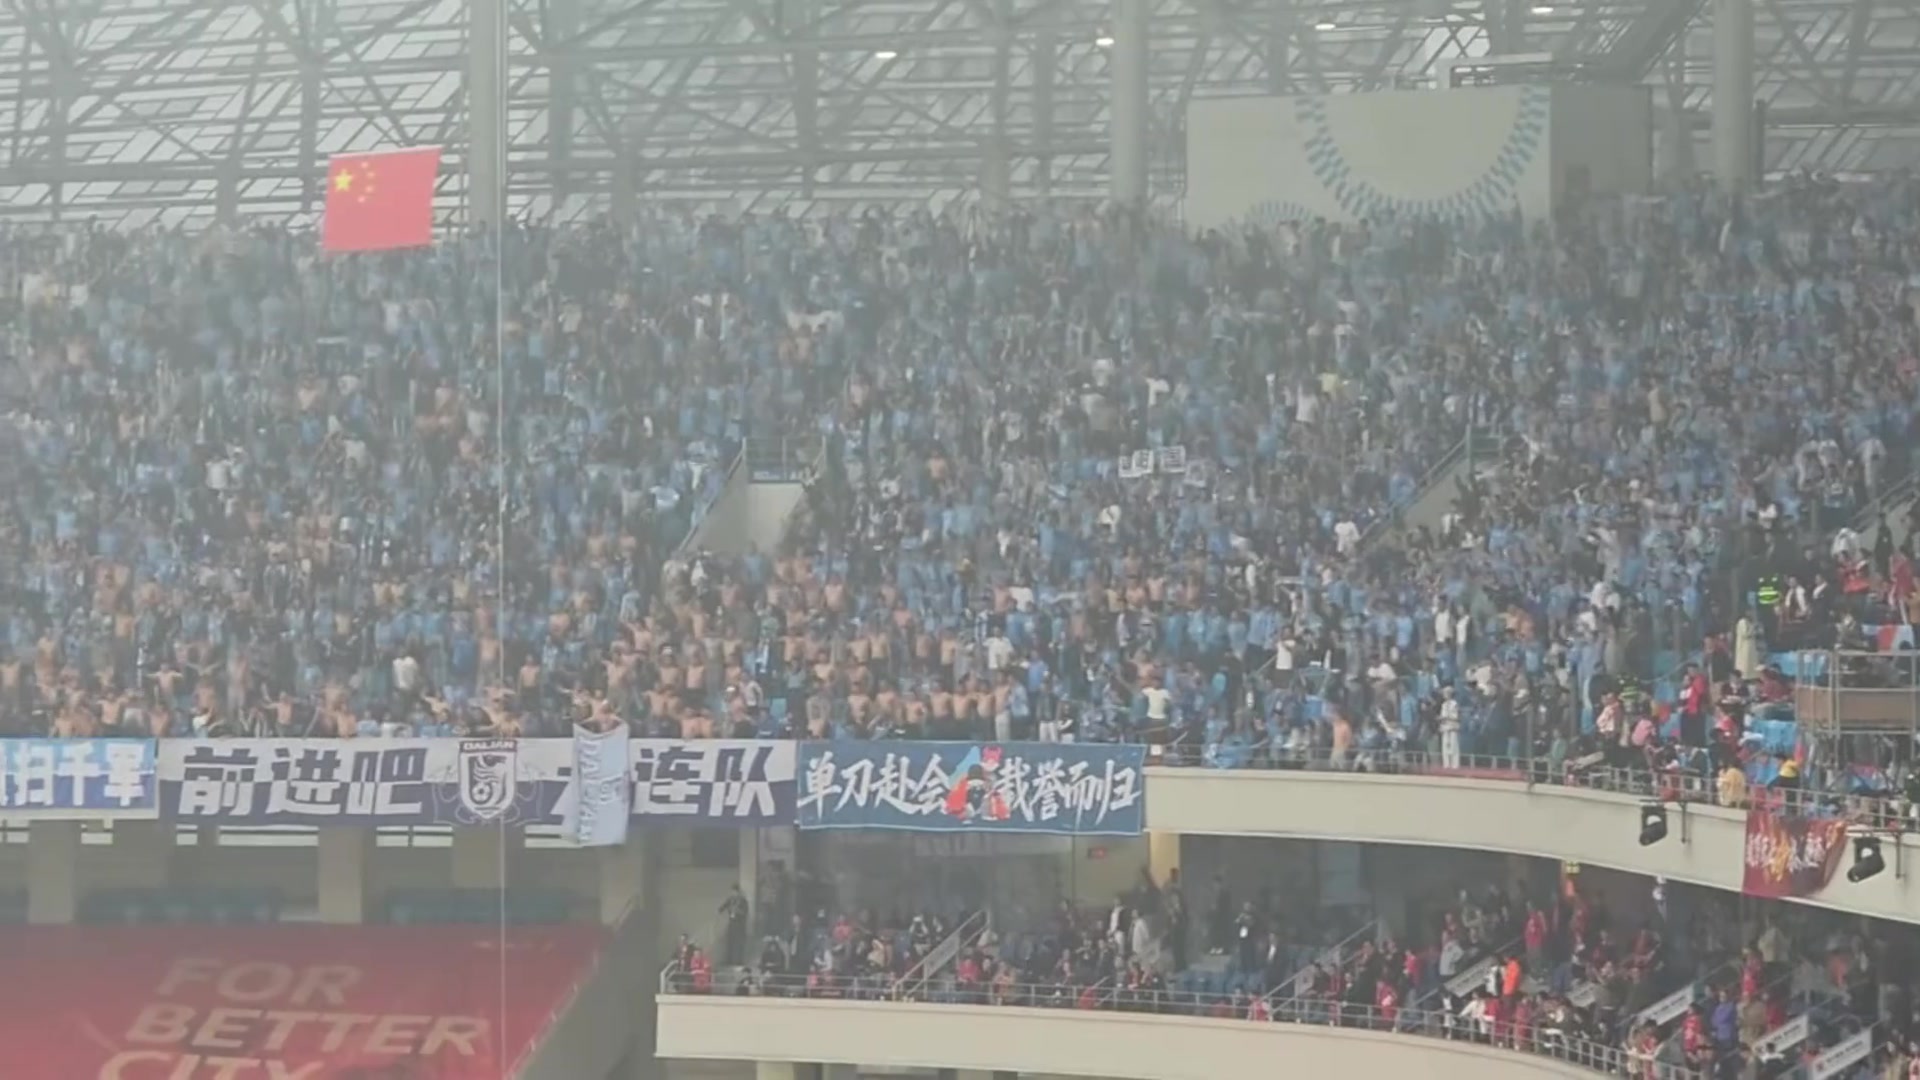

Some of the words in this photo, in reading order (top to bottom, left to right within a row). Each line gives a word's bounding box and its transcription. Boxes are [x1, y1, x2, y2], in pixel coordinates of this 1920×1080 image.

[463, 741, 514, 750] DALIAN
[178, 746, 428, 815] 前进吧
[796, 751, 952, 821] 单刀赴会
[153, 957, 363, 1005] FOR
[125, 1003, 492, 1056] BETTER
